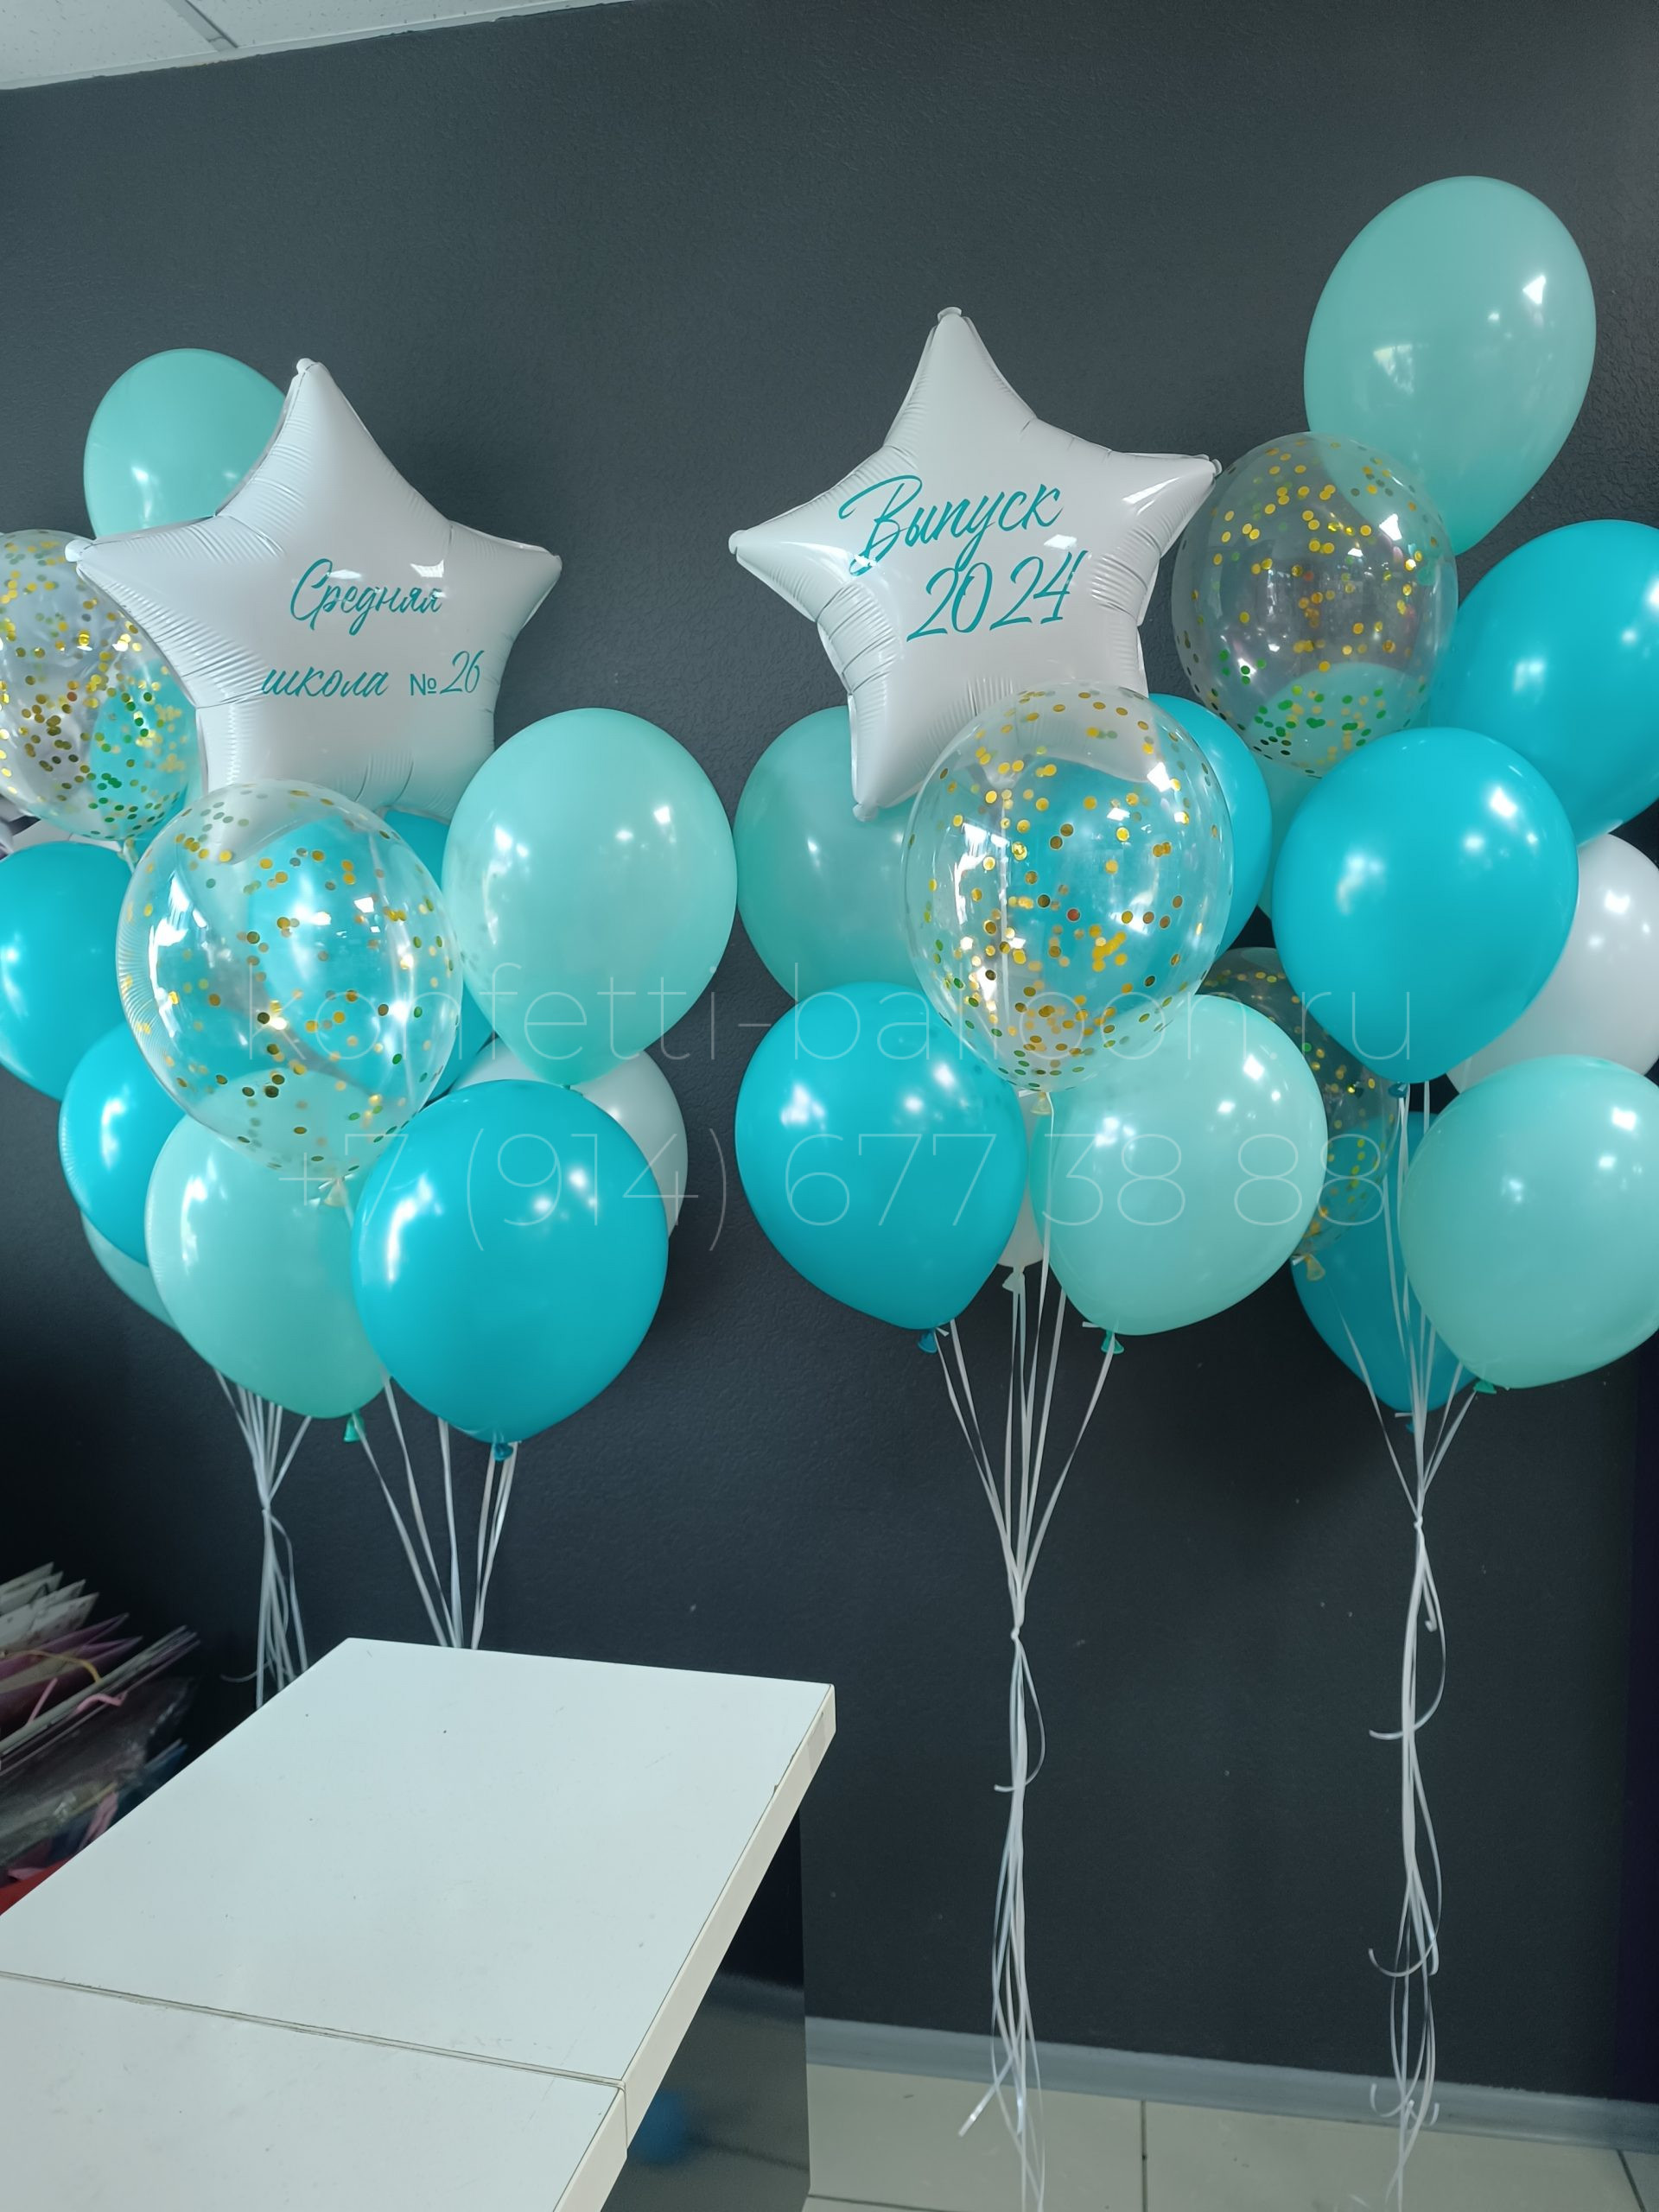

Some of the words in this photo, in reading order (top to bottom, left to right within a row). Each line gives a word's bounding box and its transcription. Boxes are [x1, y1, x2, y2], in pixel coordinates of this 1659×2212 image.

[838, 474, 1064, 576] Выпуск
[289, 558, 443, 636] Средняя
[906, 550, 1089, 642] 2024
[261, 666, 389, 697] школа
